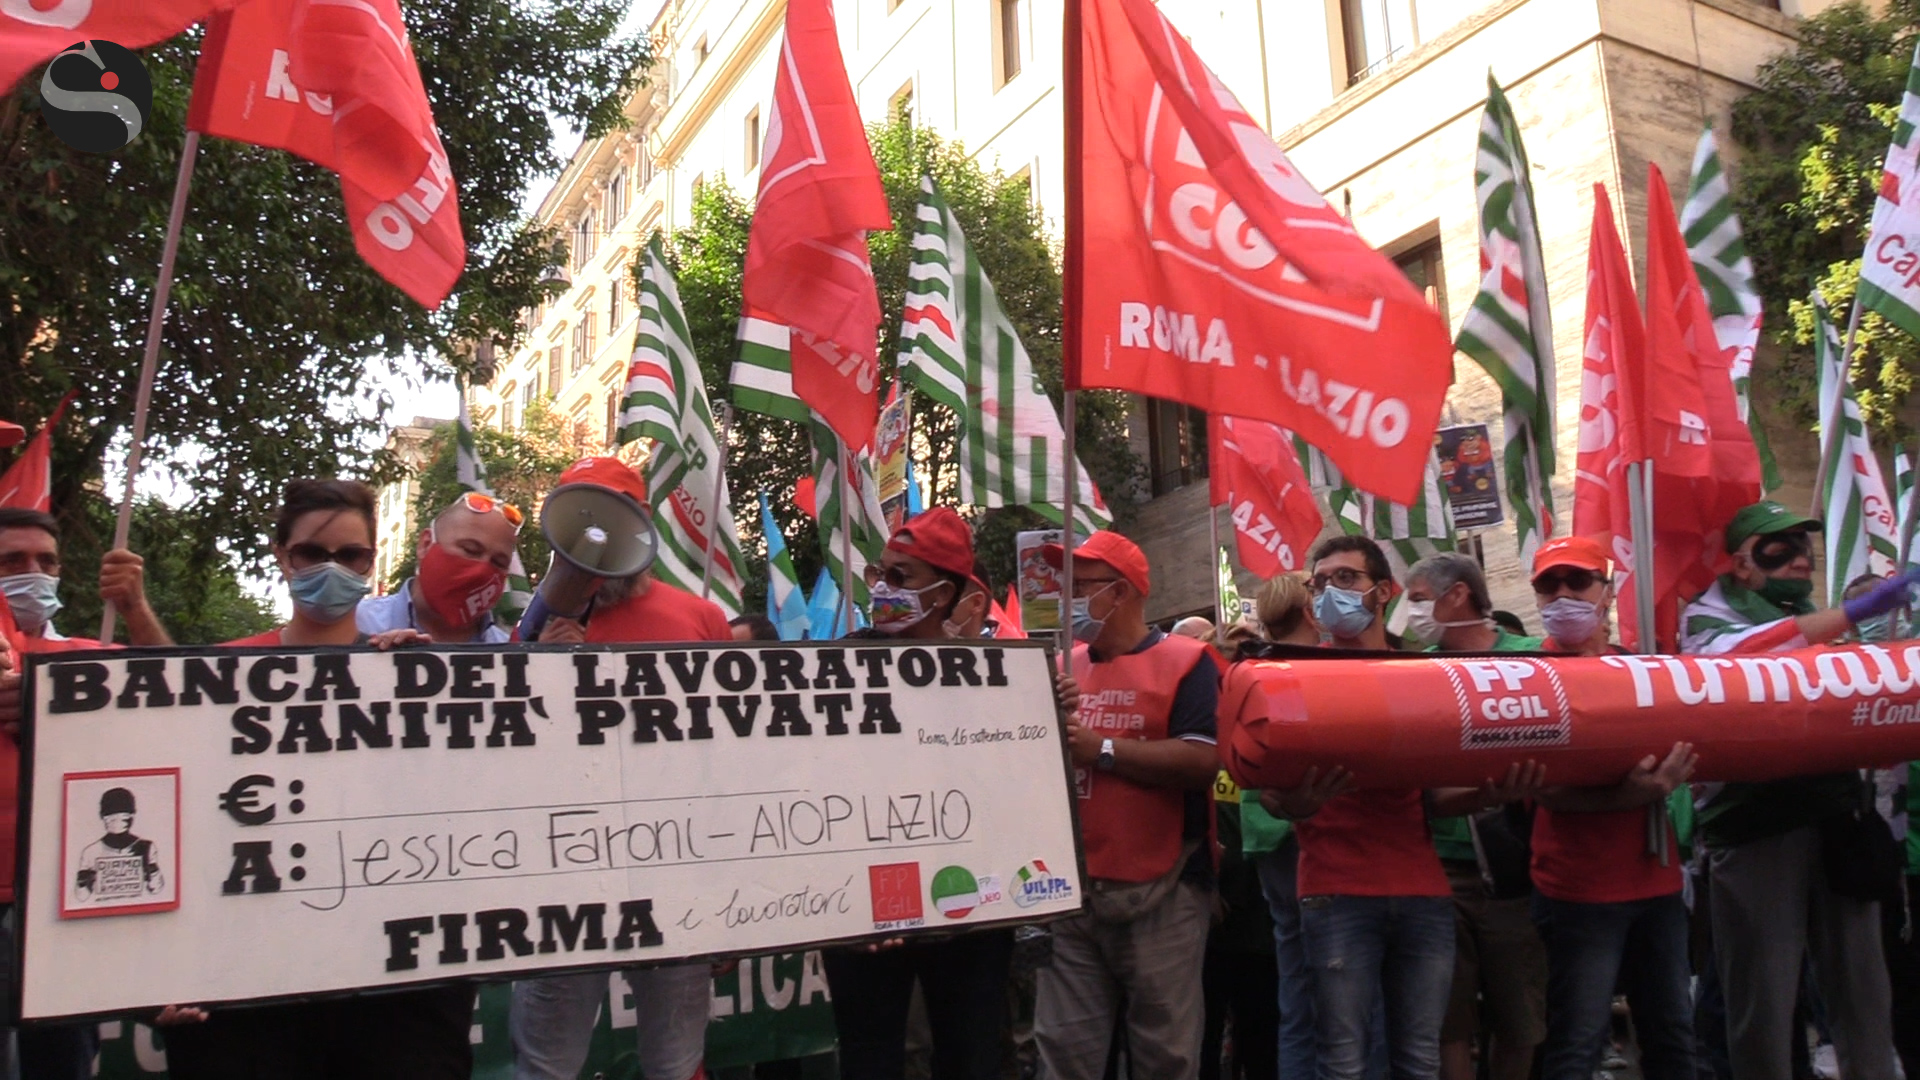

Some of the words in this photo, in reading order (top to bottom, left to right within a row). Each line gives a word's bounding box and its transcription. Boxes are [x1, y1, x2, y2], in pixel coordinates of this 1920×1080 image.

[1120, 302, 1236, 368] ROMA
[1280, 355, 1410, 449] LAZIO
[465, 583, 497, 617] FP
[48, 654, 361, 714] BANCA
[393, 652, 532, 699] DEI
[572, 647, 1008, 698] LAVORATORI
[1464, 660, 1536, 693] FP
[1601, 644, 1920, 708] Firmat
[575, 692, 902, 745] PRIVATA
[1481, 695, 1549, 721] CGIL
[952, 727, 967, 746] 16
[1018, 724, 1048, 740] 2020
[222, 841, 306, 895] A:
[301, 830, 522, 910] Jessica
[547, 804, 704, 868] Faroni
[750, 795, 852, 853] AIOP
[862, 789, 972, 842] LAZIO
[716, 875, 855, 929] lavoratori
[875, 895, 918, 918] CGIL
[879, 867, 909, 893] FP
[384, 899, 664, 972] FIRMA
